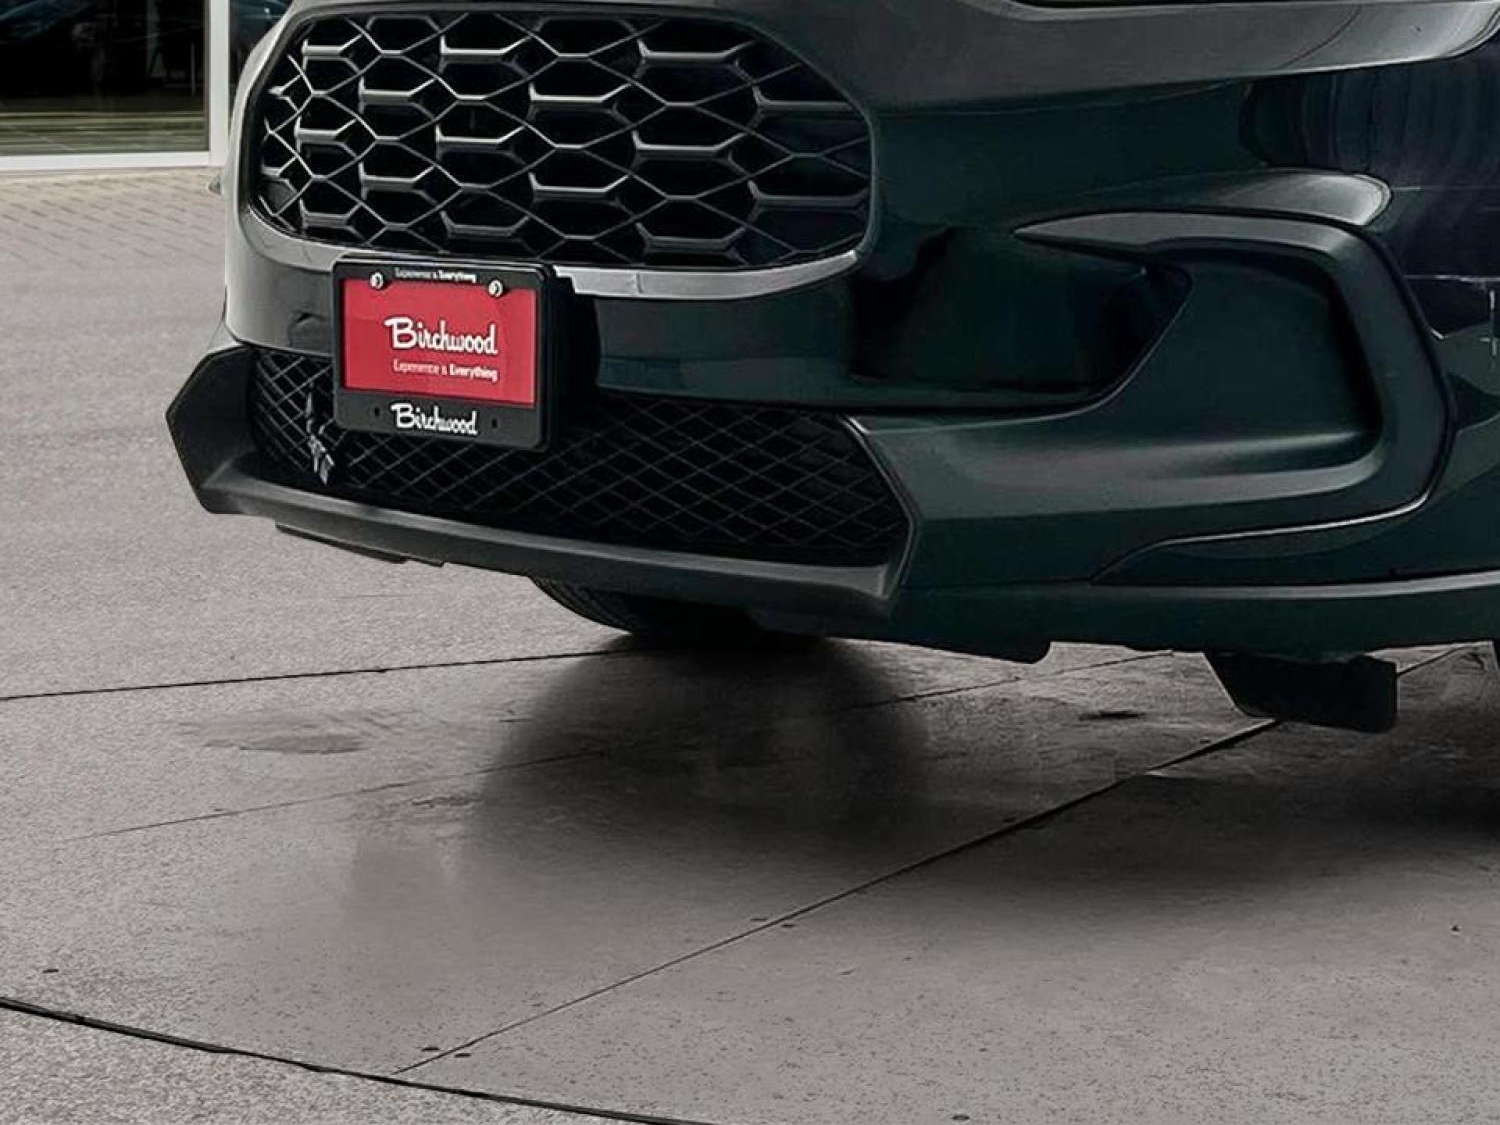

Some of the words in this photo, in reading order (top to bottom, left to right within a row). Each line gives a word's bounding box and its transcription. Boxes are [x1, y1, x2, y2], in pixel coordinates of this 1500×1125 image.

[384, 317, 498, 355] Birchwood
[449, 363, 498, 383] Everything
[390, 402, 478, 436] Birchwood
